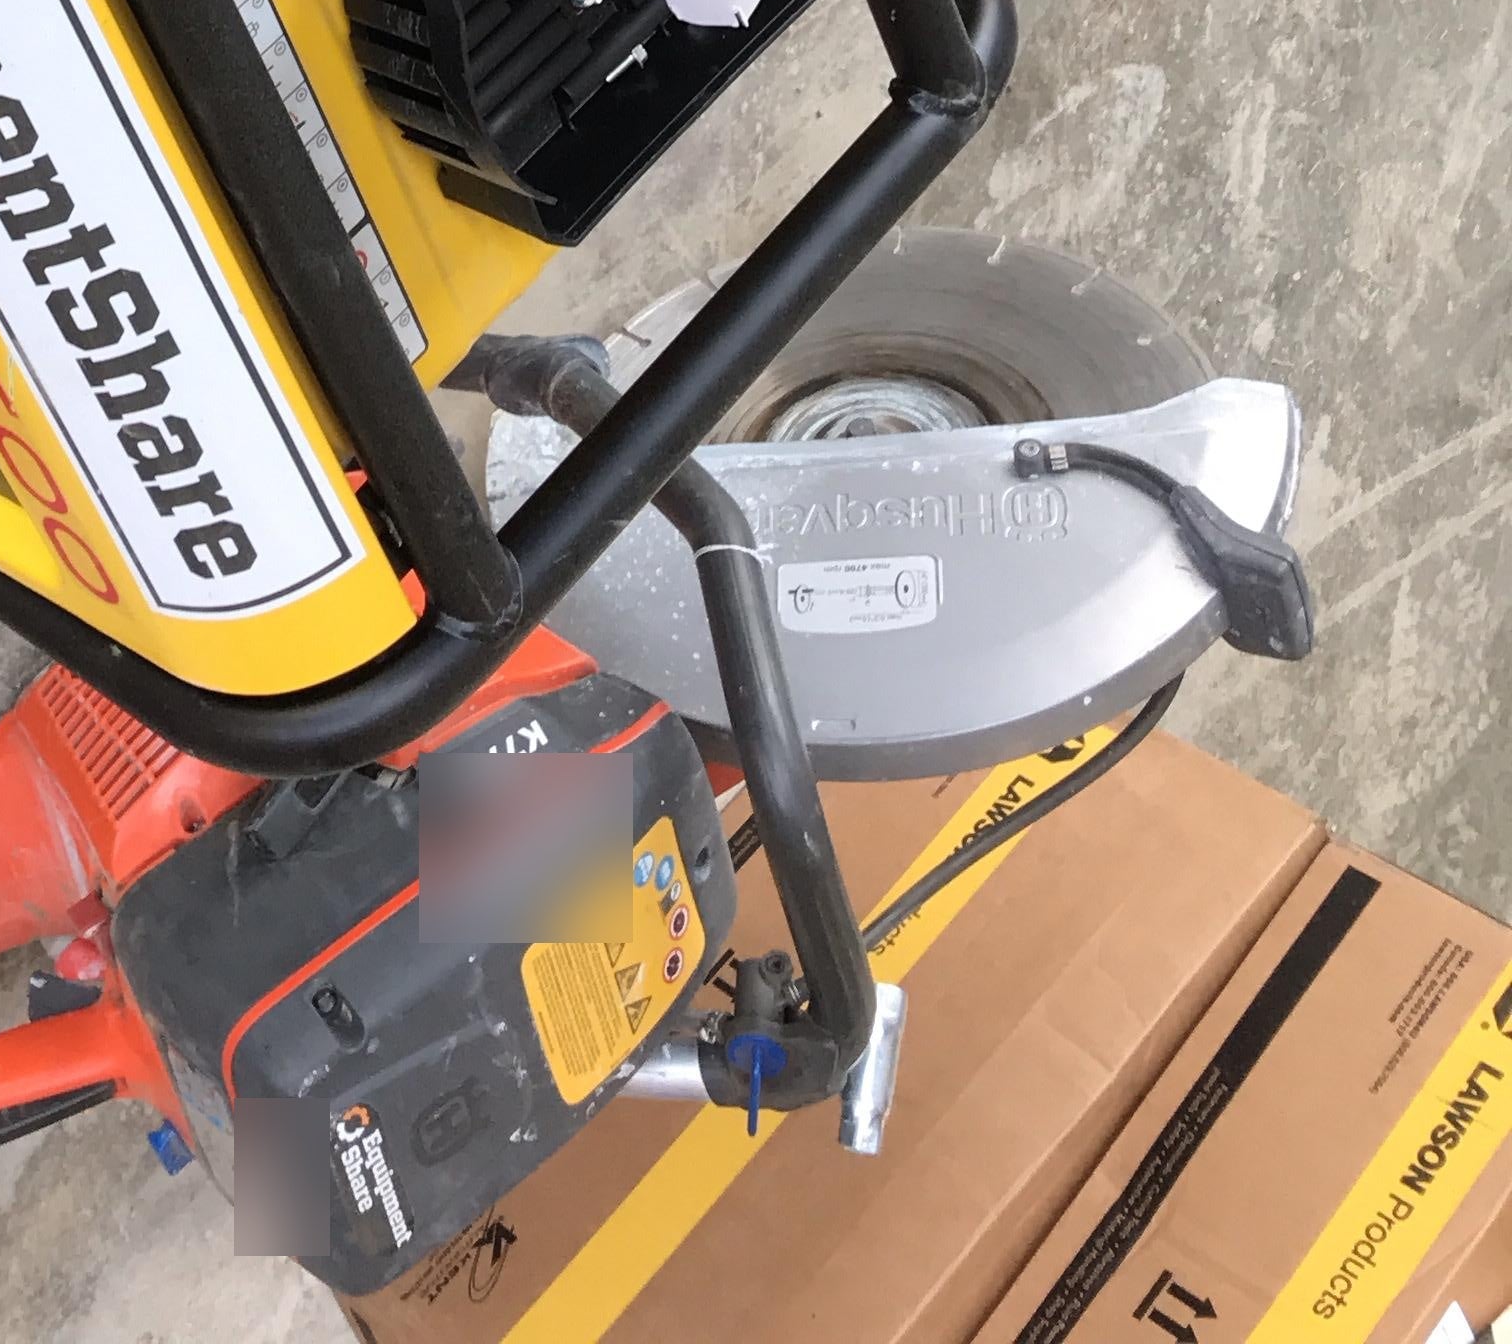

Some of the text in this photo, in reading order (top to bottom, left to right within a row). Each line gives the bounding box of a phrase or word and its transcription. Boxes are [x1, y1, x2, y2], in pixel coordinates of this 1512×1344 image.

[340, 1143, 374, 1214] Share
[362, 1127, 413, 1249] Equipment
[1308, 1059, 1504, 1324] LAWSON Products
